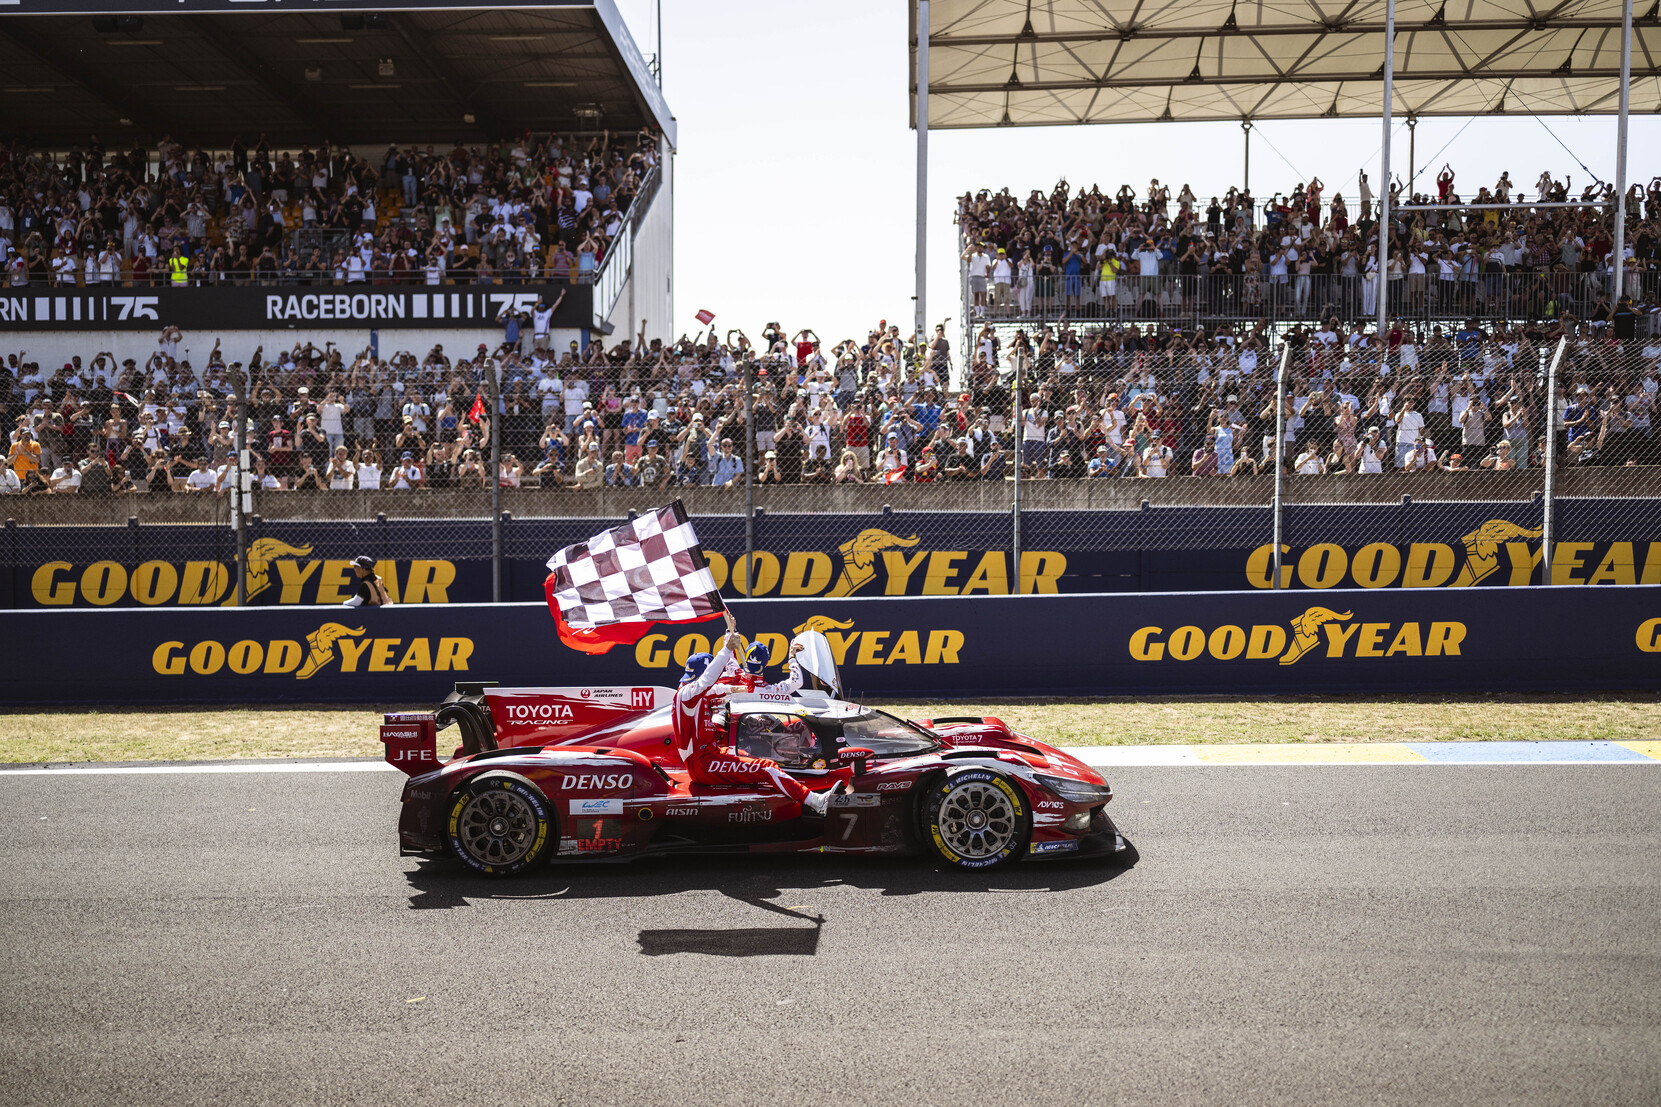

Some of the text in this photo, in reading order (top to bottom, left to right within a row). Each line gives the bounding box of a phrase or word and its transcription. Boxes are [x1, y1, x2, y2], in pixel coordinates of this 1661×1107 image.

[110, 296, 159, 321] 75
[266, 293, 539, 319] RACEBORN 75
[632, 691, 653, 707] HY
[759, 693, 791, 701] TOYOTA
[505, 704, 574, 719] TOYOTA
[393, 749, 432, 761] JFE
[840, 751, 866, 759] DENSO
[707, 760, 761, 774] DENSO
[561, 773, 634, 790] DENSO
[876, 780, 913, 791] RAYS
[955, 773, 992, 785] MICHELIN
[410, 789, 431, 800] Mobil
[581, 800, 611, 809] WEC
[592, 819, 604, 840] 1
[839, 813, 858, 841] 7
[577, 838, 622, 852] EMPTY
